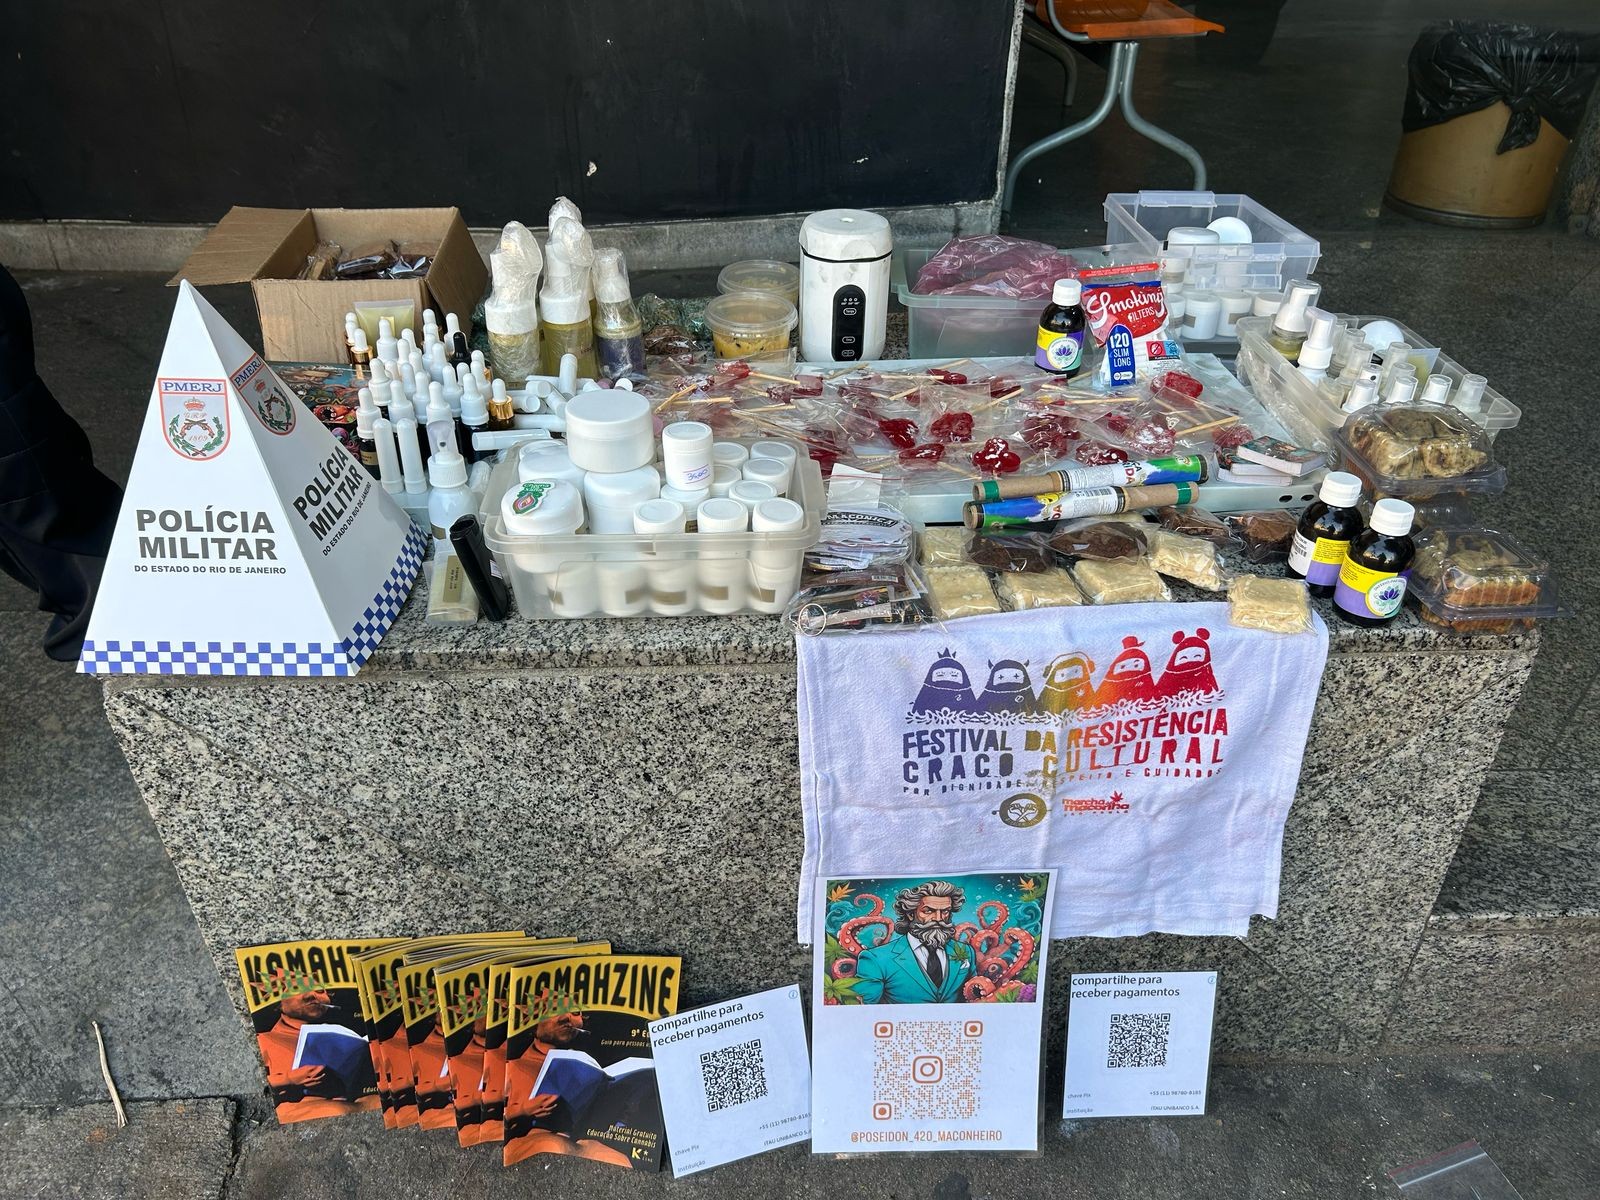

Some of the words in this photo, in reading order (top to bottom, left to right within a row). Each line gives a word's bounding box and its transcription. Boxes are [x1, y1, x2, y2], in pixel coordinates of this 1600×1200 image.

[1086, 288, 1165, 330] Smoking
[1127, 306, 1156, 323] FILTERS
[1109, 333, 1130, 349] 120
[1113, 348, 1130, 358] SLIM
[234, 357, 262, 387] PMERJ
[1113, 357, 1132, 367] LONG
[163, 382, 222, 392] PMERJ
[292, 445, 349, 521] POLÍCIA
[308, 464, 364, 541] MILITAR
[136, 505, 275, 533] POLÍCIA
[322, 545, 332, 556] DO
[329, 523, 349, 547] ESTADO
[346, 515, 354, 527] DO
[352, 506, 360, 518] RIO
[358, 499, 364, 508] DE
[139, 536, 278, 560] MILITAR
[151, 565, 190, 573] ESTADO
[192, 565, 206, 573] DO
[209, 566, 226, 574] RIO
[229, 566, 242, 574] DE
[244, 566, 287, 574] JANEIRO
[902, 728, 1013, 759] FESTIVAL
[1024, 729, 1057, 754] DA
[1067, 708, 1228, 749] RESISTÊNCIA
[902, 753, 1014, 784] CRACO
[1042, 737, 1224, 779] CULTURAL
[903, 786, 930, 796] POR
[1125, 769, 1132, 777] E
[1144, 767, 1222, 778] CUIDADOS
[1071, 988, 1111, 998] receber
[1113, 987, 1180, 999] pagamentos
[1072, 975, 1137, 989] compartilhe
[1138, 976, 1163, 988] para
[513, 962, 675, 1031] KAMAHZINE
[651, 1008, 717, 1034] compartilhe
[719, 1003, 743, 1018] para
[653, 1029, 695, 1048] receber
[697, 1011, 765, 1038] pagamentos
[586, 1128, 613, 1139] Educação
[614, 1133, 630, 1143] Sobre
[631, 1137, 657, 1148] Cannabis
[608, 1124, 632, 1134] Material
[633, 1129, 657, 1139] Gratuito
[776, 1131, 803, 1143] UNIBANCO
[851, 1130, 1003, 1143] @POSEIDON_420_MACONHEIRO
